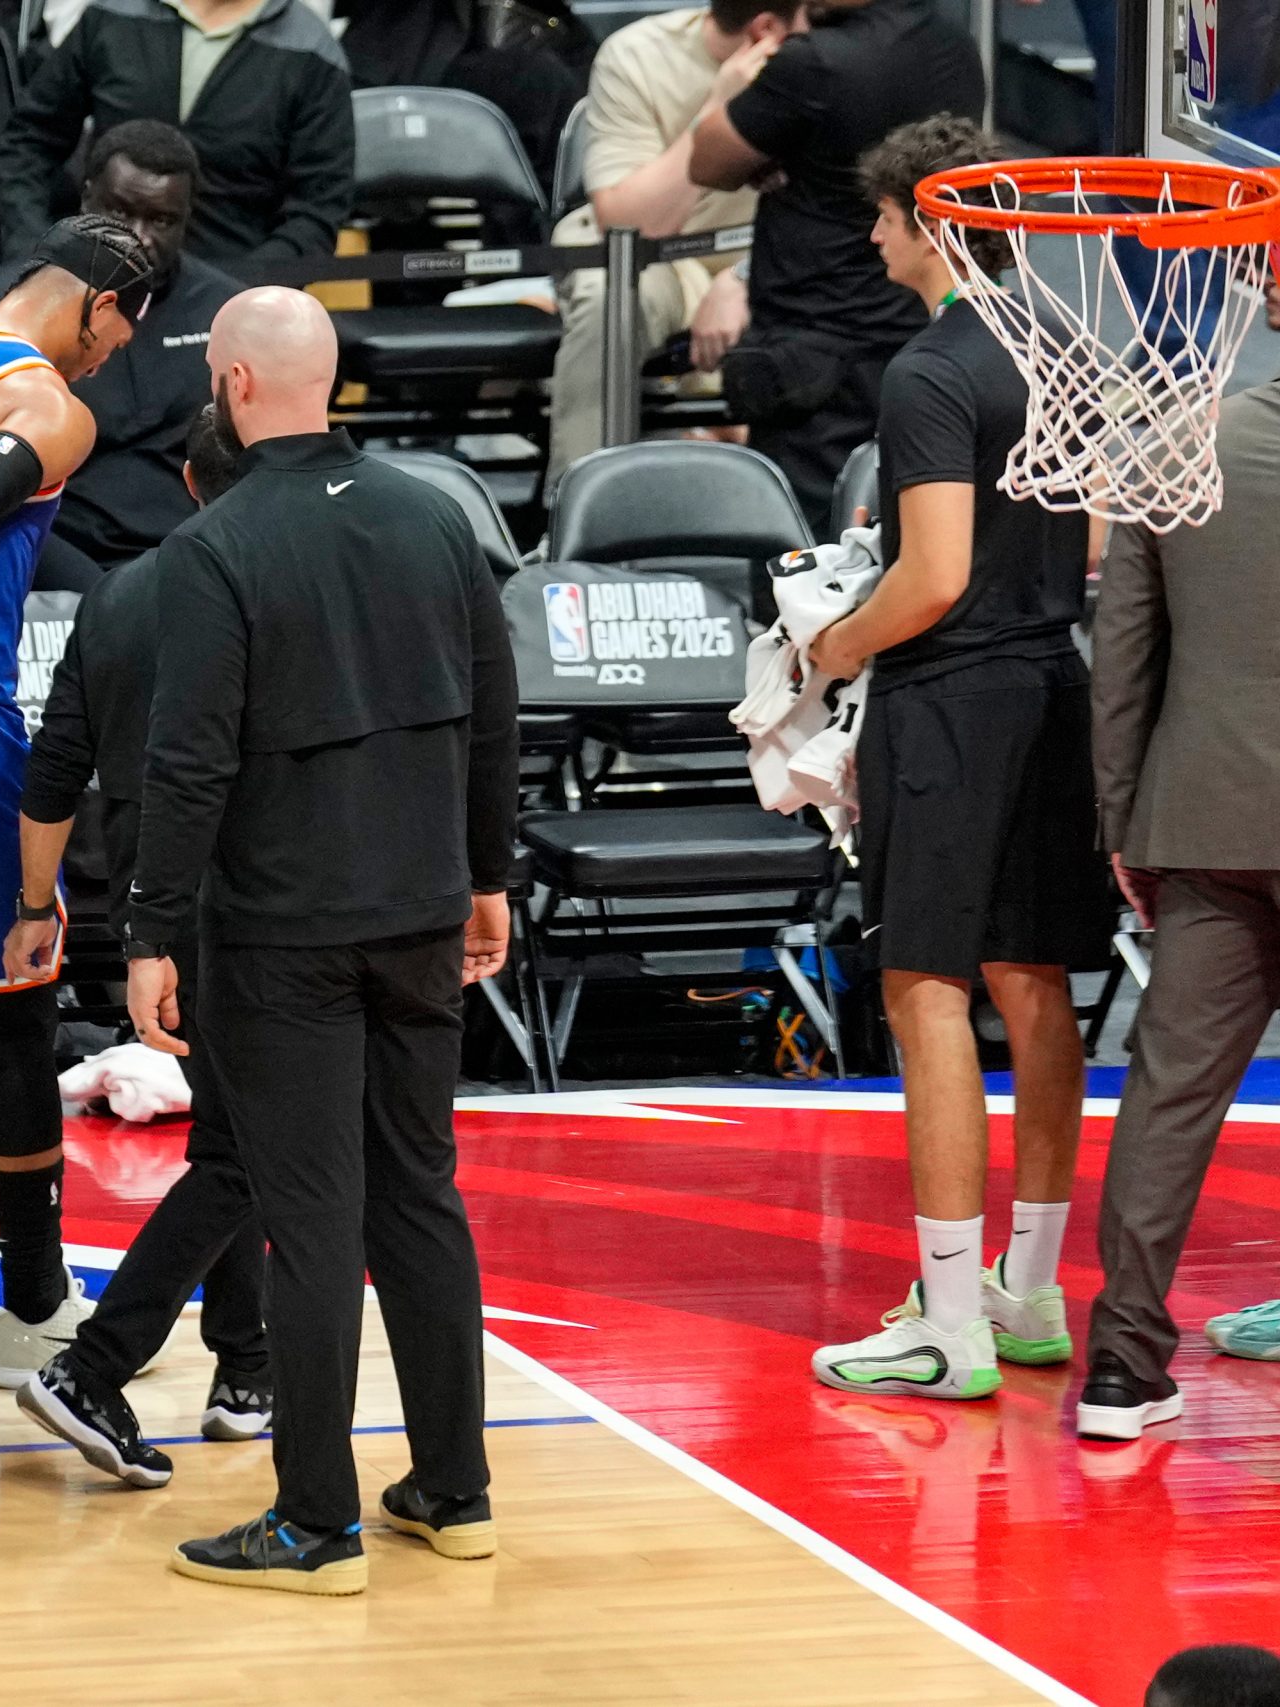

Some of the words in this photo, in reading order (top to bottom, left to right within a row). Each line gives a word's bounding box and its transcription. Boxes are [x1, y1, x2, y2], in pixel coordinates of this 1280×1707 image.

[1190, 58, 1205, 92] NBA
[587, 583, 636, 621] ABU
[634, 581, 707, 620] DHABI
[591, 620, 669, 660] GAMES
[669, 616, 734, 658] 2025
[597, 663, 646, 685] ADQ
